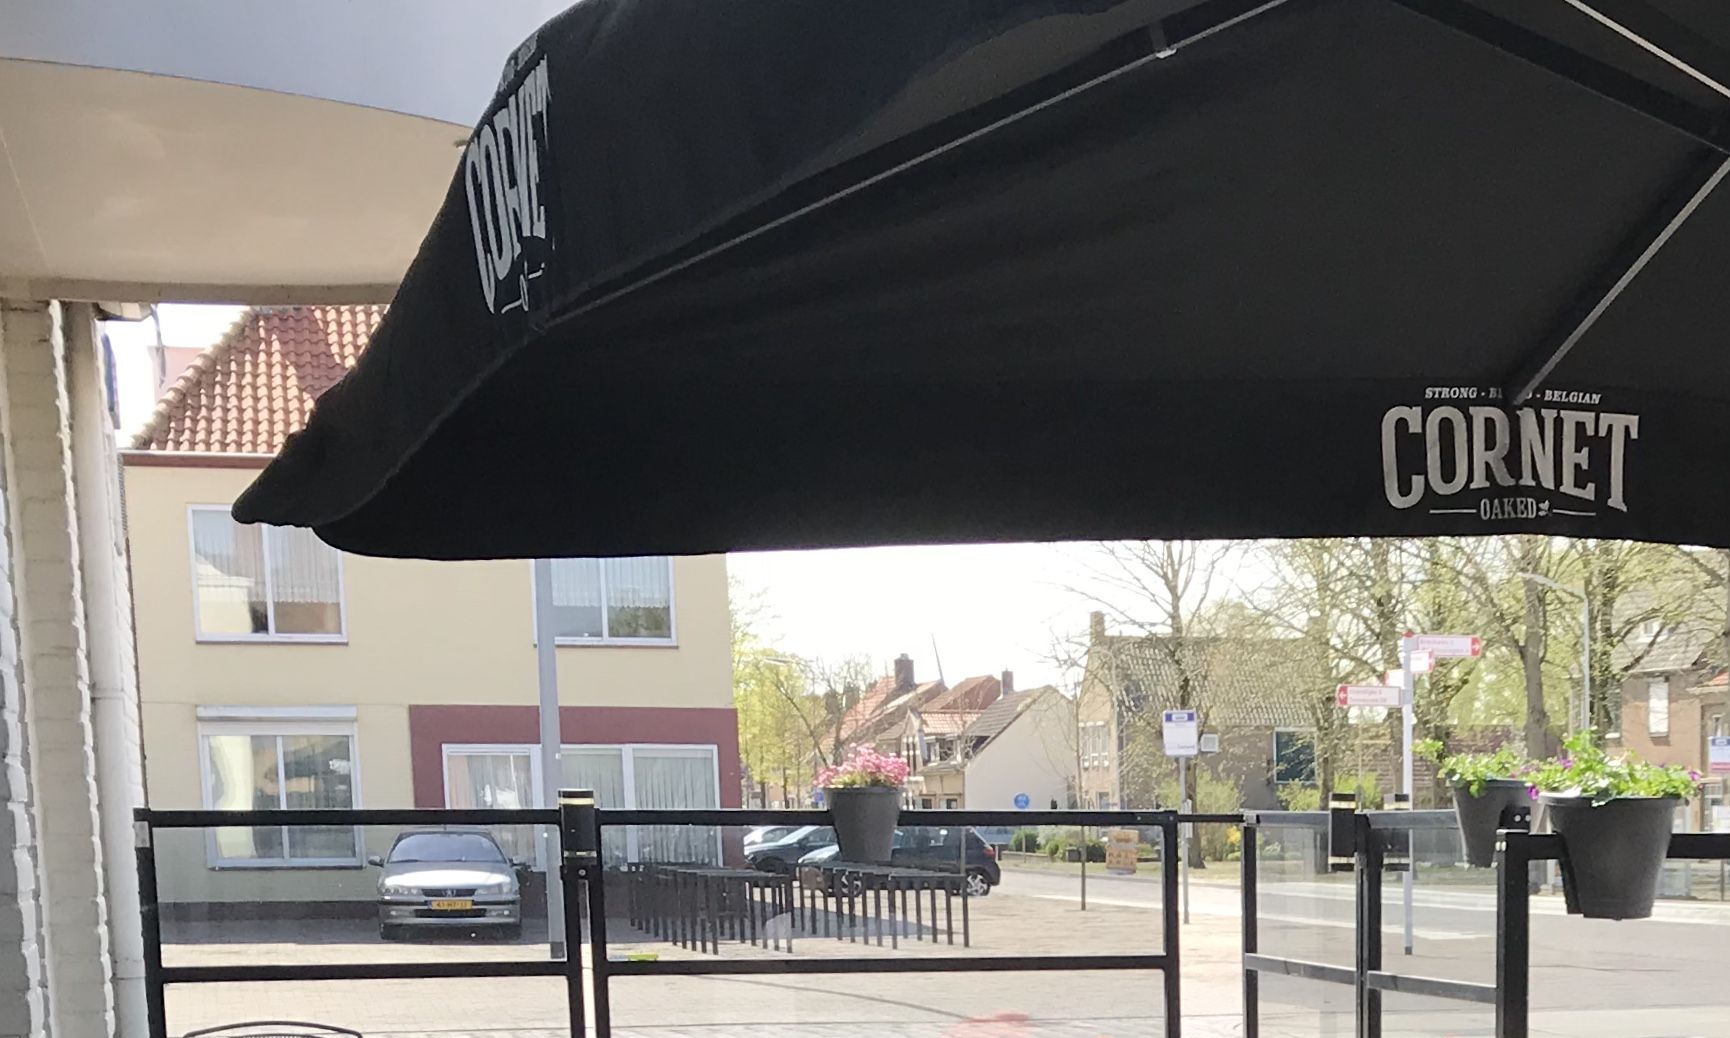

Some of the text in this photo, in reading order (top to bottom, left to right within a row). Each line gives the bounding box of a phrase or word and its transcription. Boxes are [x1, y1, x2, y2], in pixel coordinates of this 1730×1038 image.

[1424, 387, 1478, 399] STRONG
[1543, 389, 1603, 404] BELGIAN
[1380, 405, 1640, 513] CORNET
[1479, 497, 1537, 521] OAKED
